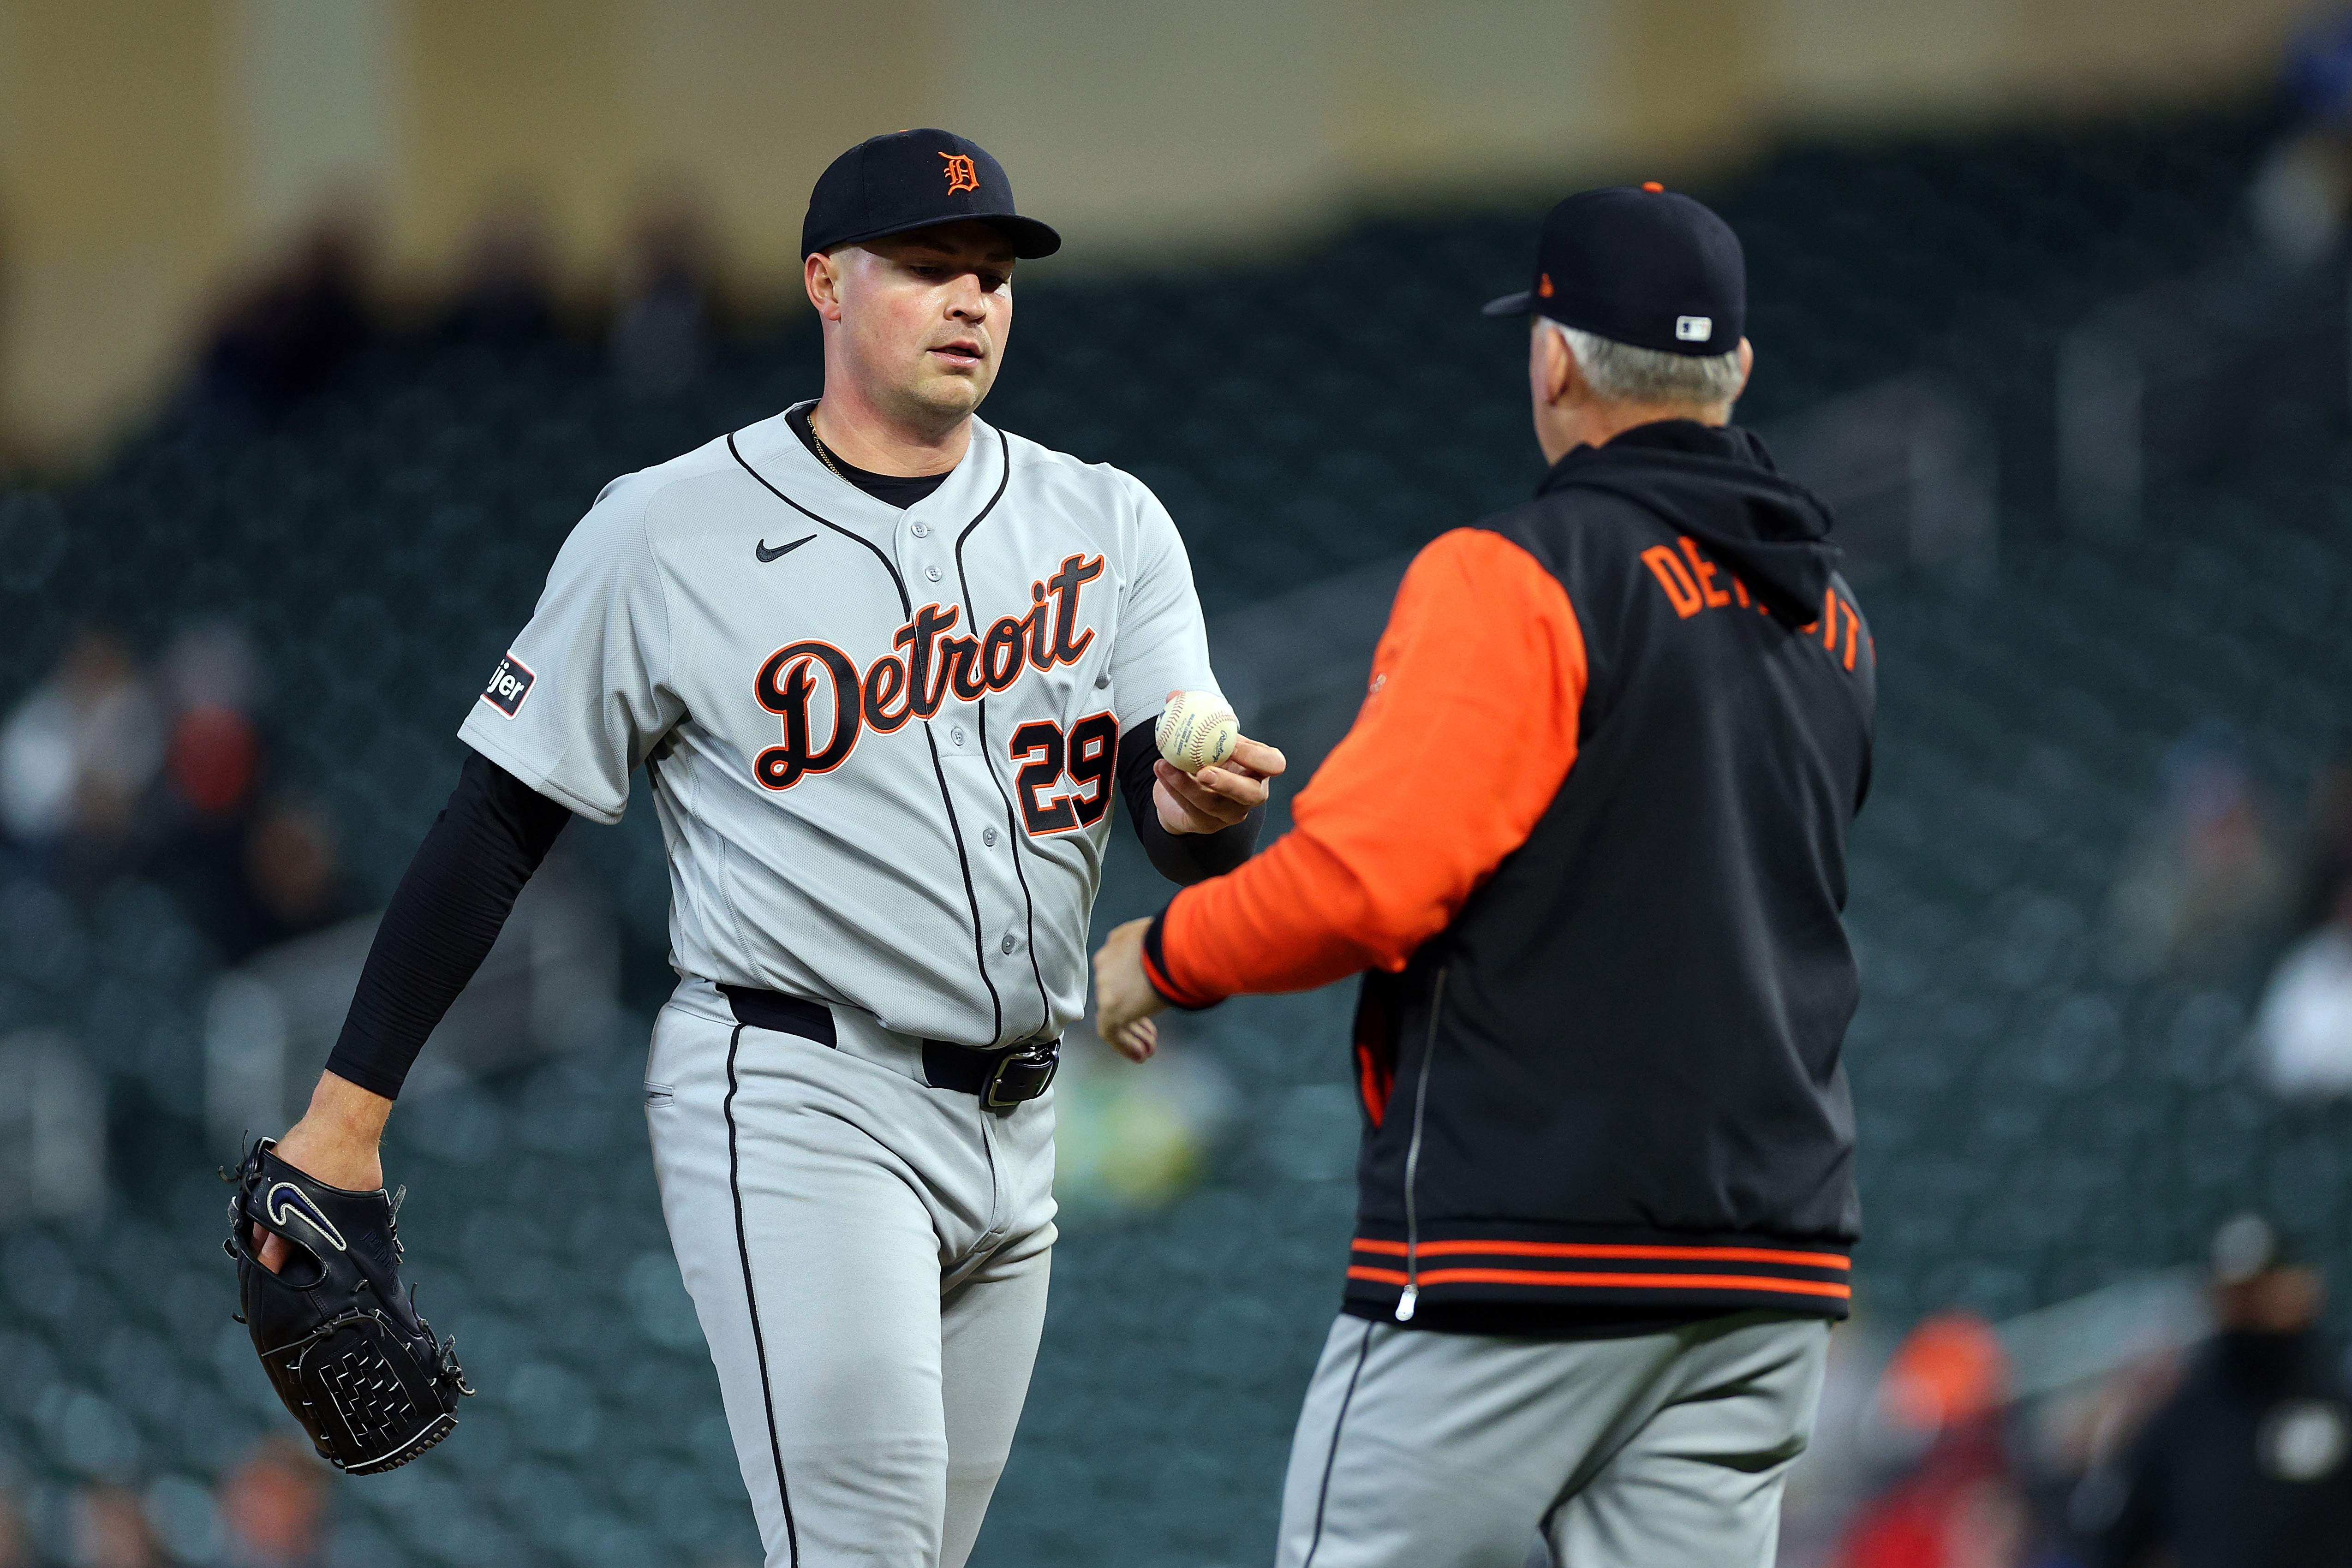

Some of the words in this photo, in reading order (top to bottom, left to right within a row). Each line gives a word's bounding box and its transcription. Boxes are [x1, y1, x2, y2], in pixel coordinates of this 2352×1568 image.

[937, 151, 980, 196] D
[754, 553, 1105, 792] Detroit
[1009, 710, 1120, 837] 29
